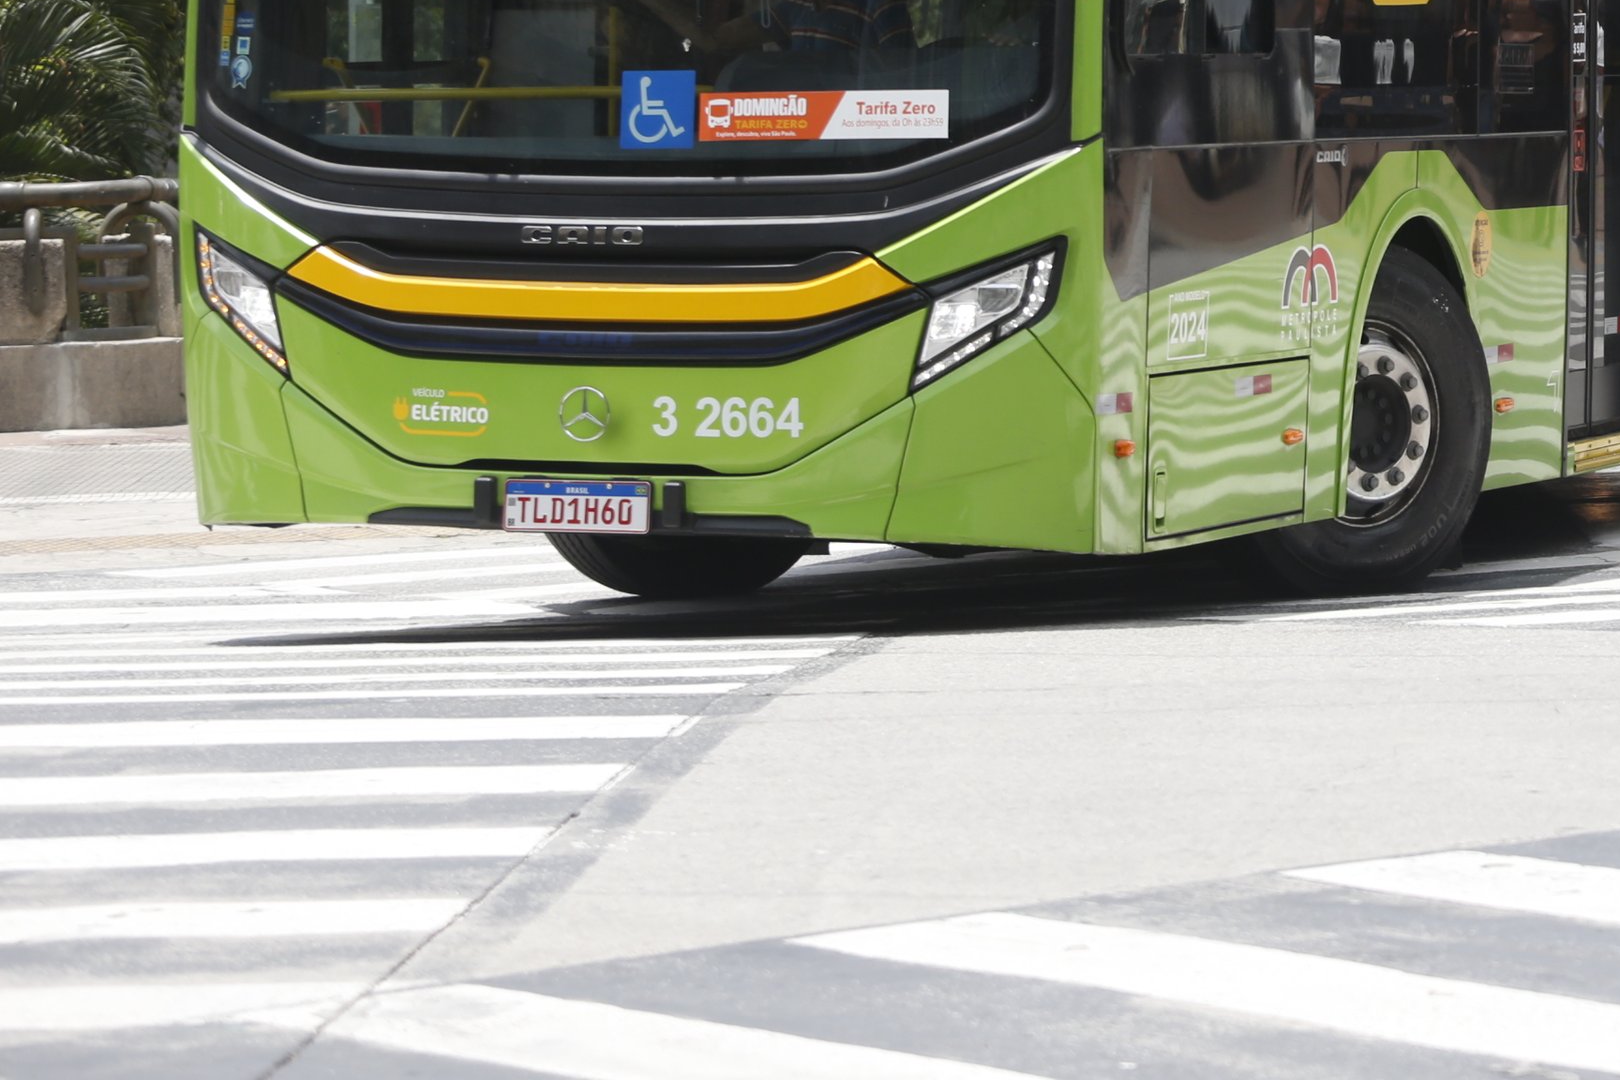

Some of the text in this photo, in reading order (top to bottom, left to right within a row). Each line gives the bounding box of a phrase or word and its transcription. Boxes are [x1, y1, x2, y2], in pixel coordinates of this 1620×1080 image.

[734, 94, 807, 117] DOMINGÃO
[856, 101, 936, 115] Tarifa Zero
[735, 119, 808, 129] TARIFA ZERO
[521, 225, 644, 246] CAIO
[1170, 311, 1206, 345] 2024
[412, 387, 445, 399] VEÍCULO
[411, 403, 489, 424] ELÉTRICO
[653, 396, 804, 439] 3 2664
[517, 497, 632, 525] TLD1H60
